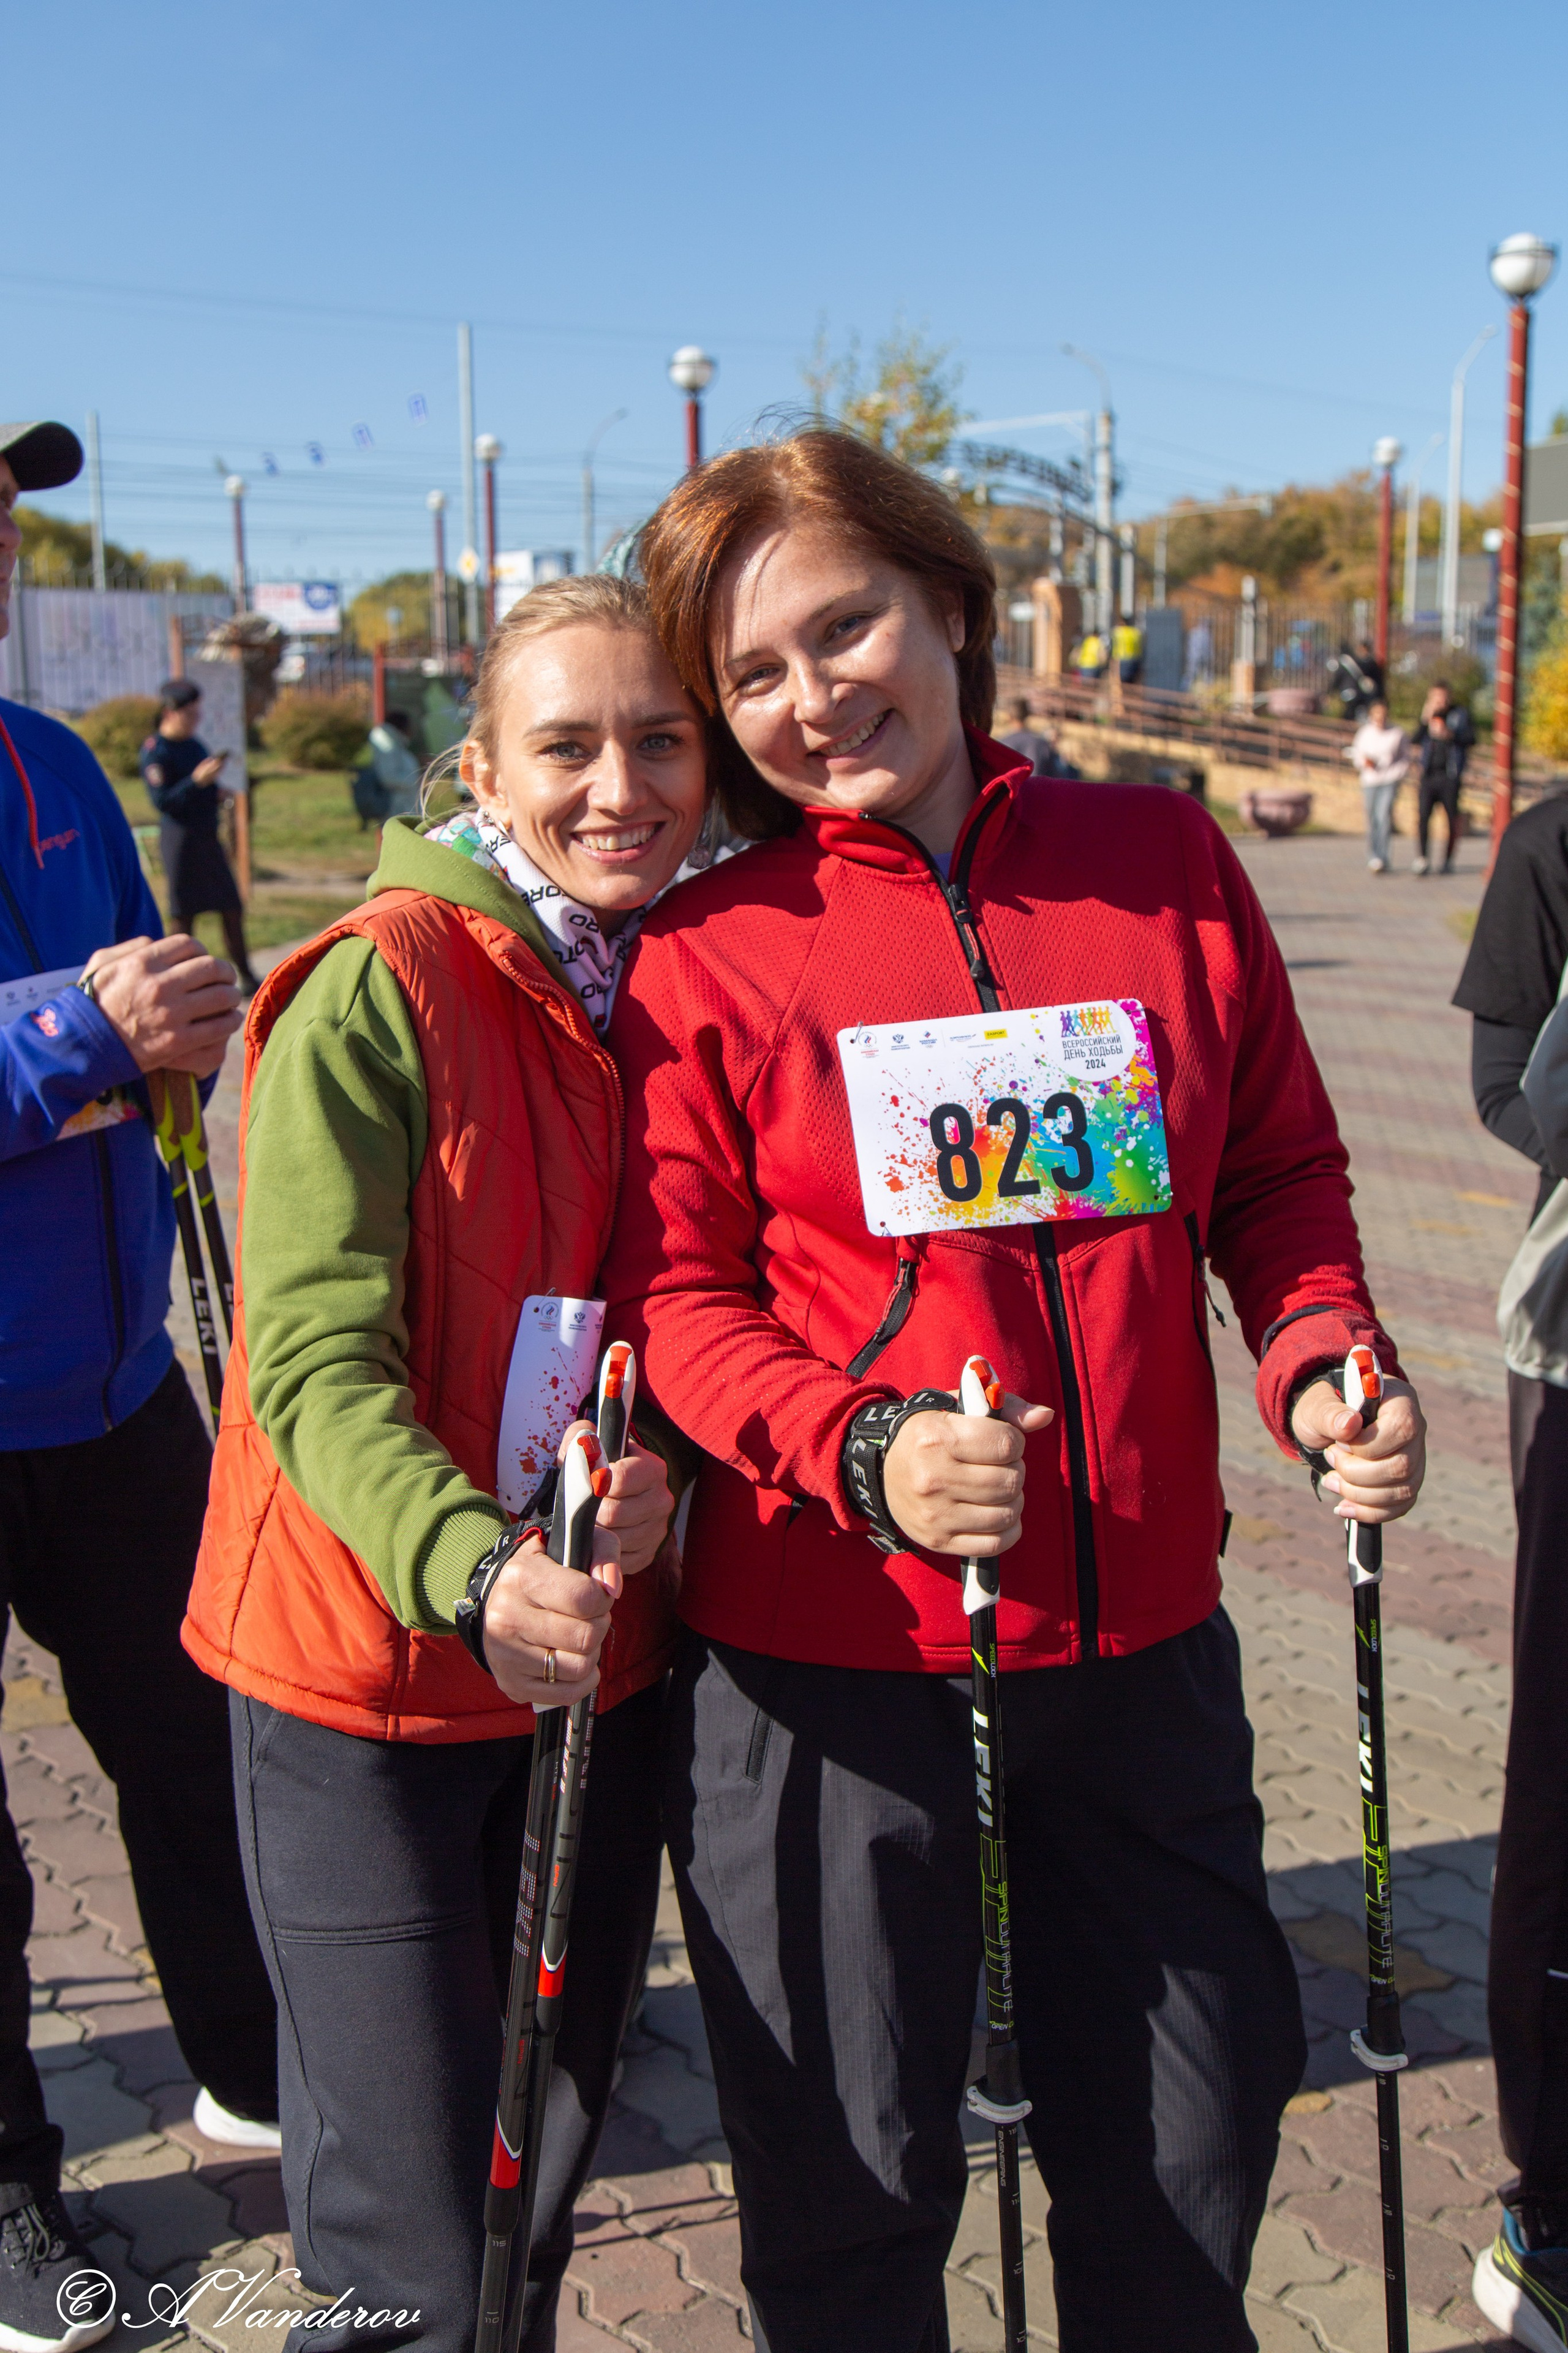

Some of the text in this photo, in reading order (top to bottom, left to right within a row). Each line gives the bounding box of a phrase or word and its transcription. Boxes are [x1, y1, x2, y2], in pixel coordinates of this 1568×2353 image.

[1062, 1035, 1121, 1049] ВСЕРОССИЙСКИЙ
[1064, 1044, 1123, 1060] ДЕНЬ ХОДЬБЫ
[1085, 1059, 1106, 1069] 2024
[930, 1092, 1095, 1203] 823
[191, 1277, 217, 1354] LEKI
[973, 1706, 993, 1827] LEKI
